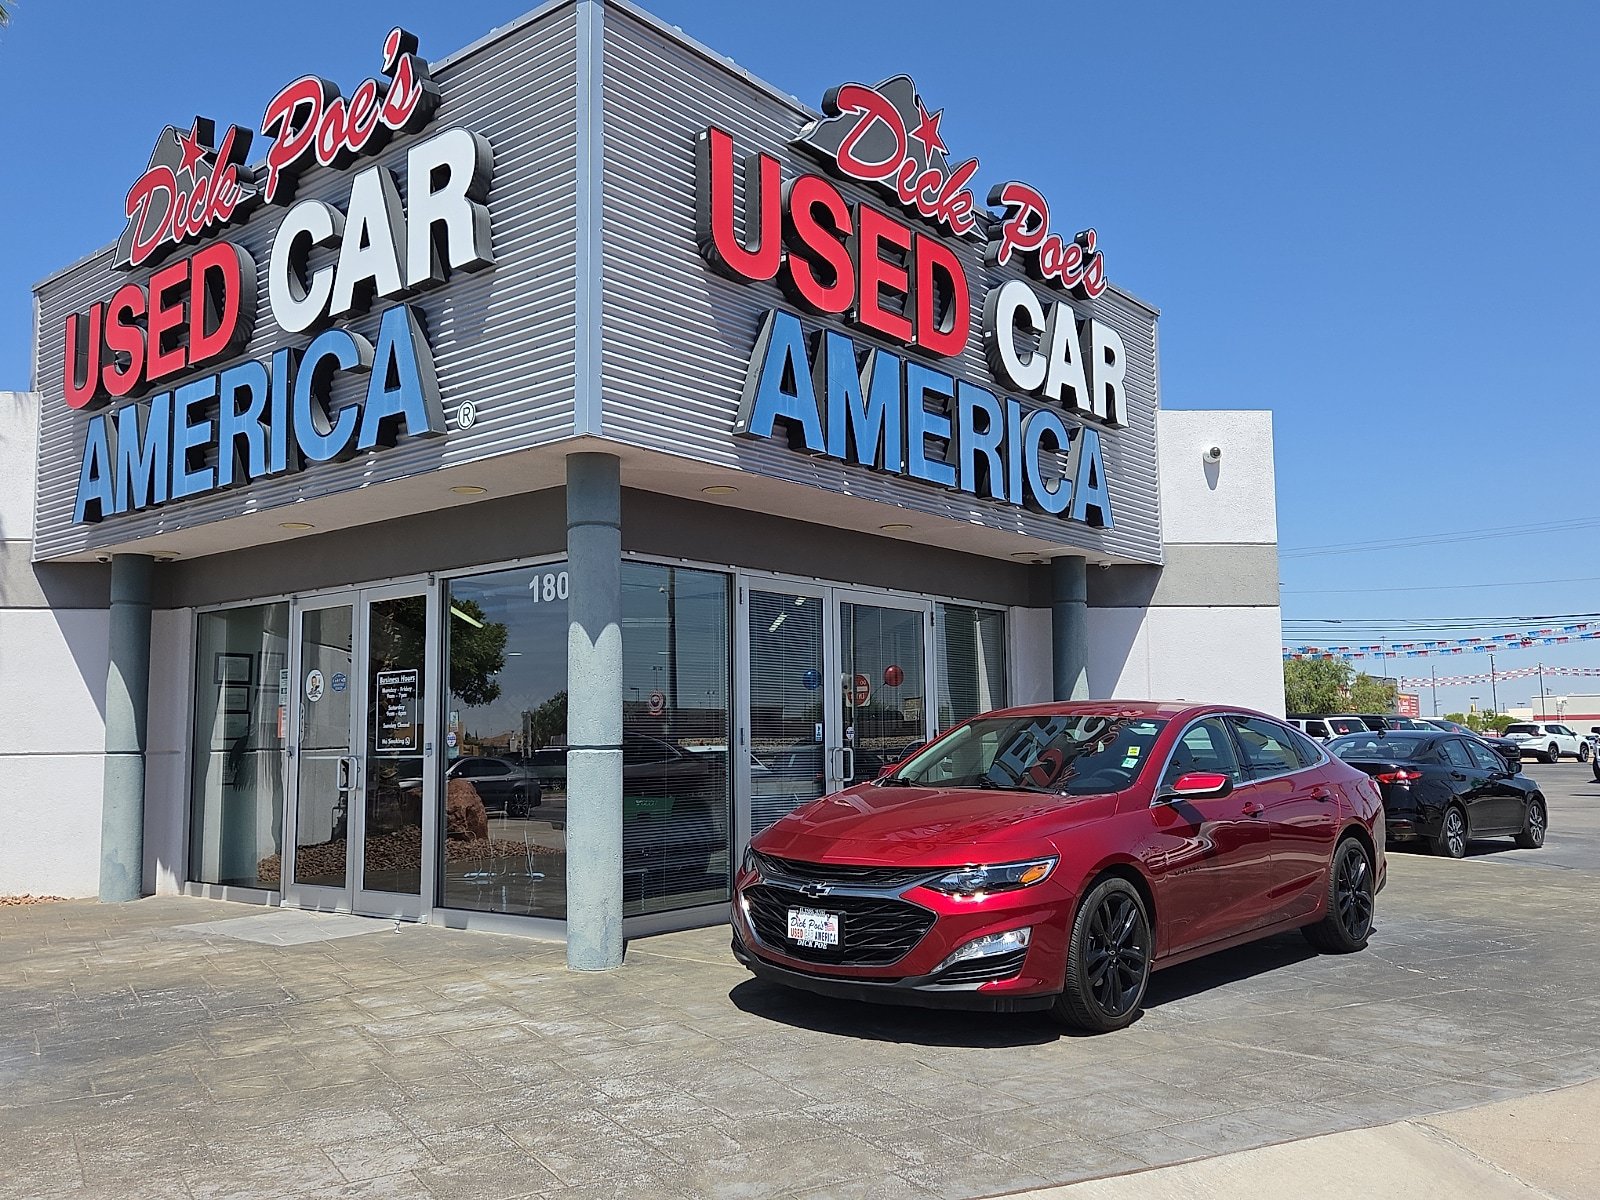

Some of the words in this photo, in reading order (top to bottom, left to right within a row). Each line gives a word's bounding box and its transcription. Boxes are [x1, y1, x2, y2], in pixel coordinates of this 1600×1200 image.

[125, 123, 242, 267] Dick
[260, 26, 428, 204] Poe's
[836, 81, 980, 236] Dick
[998, 180, 1108, 299] Poe's
[64, 240, 244, 410] USED
[267, 126, 480, 334] CAR
[708, 125, 971, 358] USED
[995, 279, 1129, 429] CAR
[72, 303, 432, 525] AMERICA
[744, 308, 1116, 530] AMERICA
[388, 738, 405, 746] Smoking
[790, 916, 806, 928] Dick
[790, 928, 804, 938] USED
[814, 932, 836, 943] AMERICA
[814, 942, 828, 950] POE
